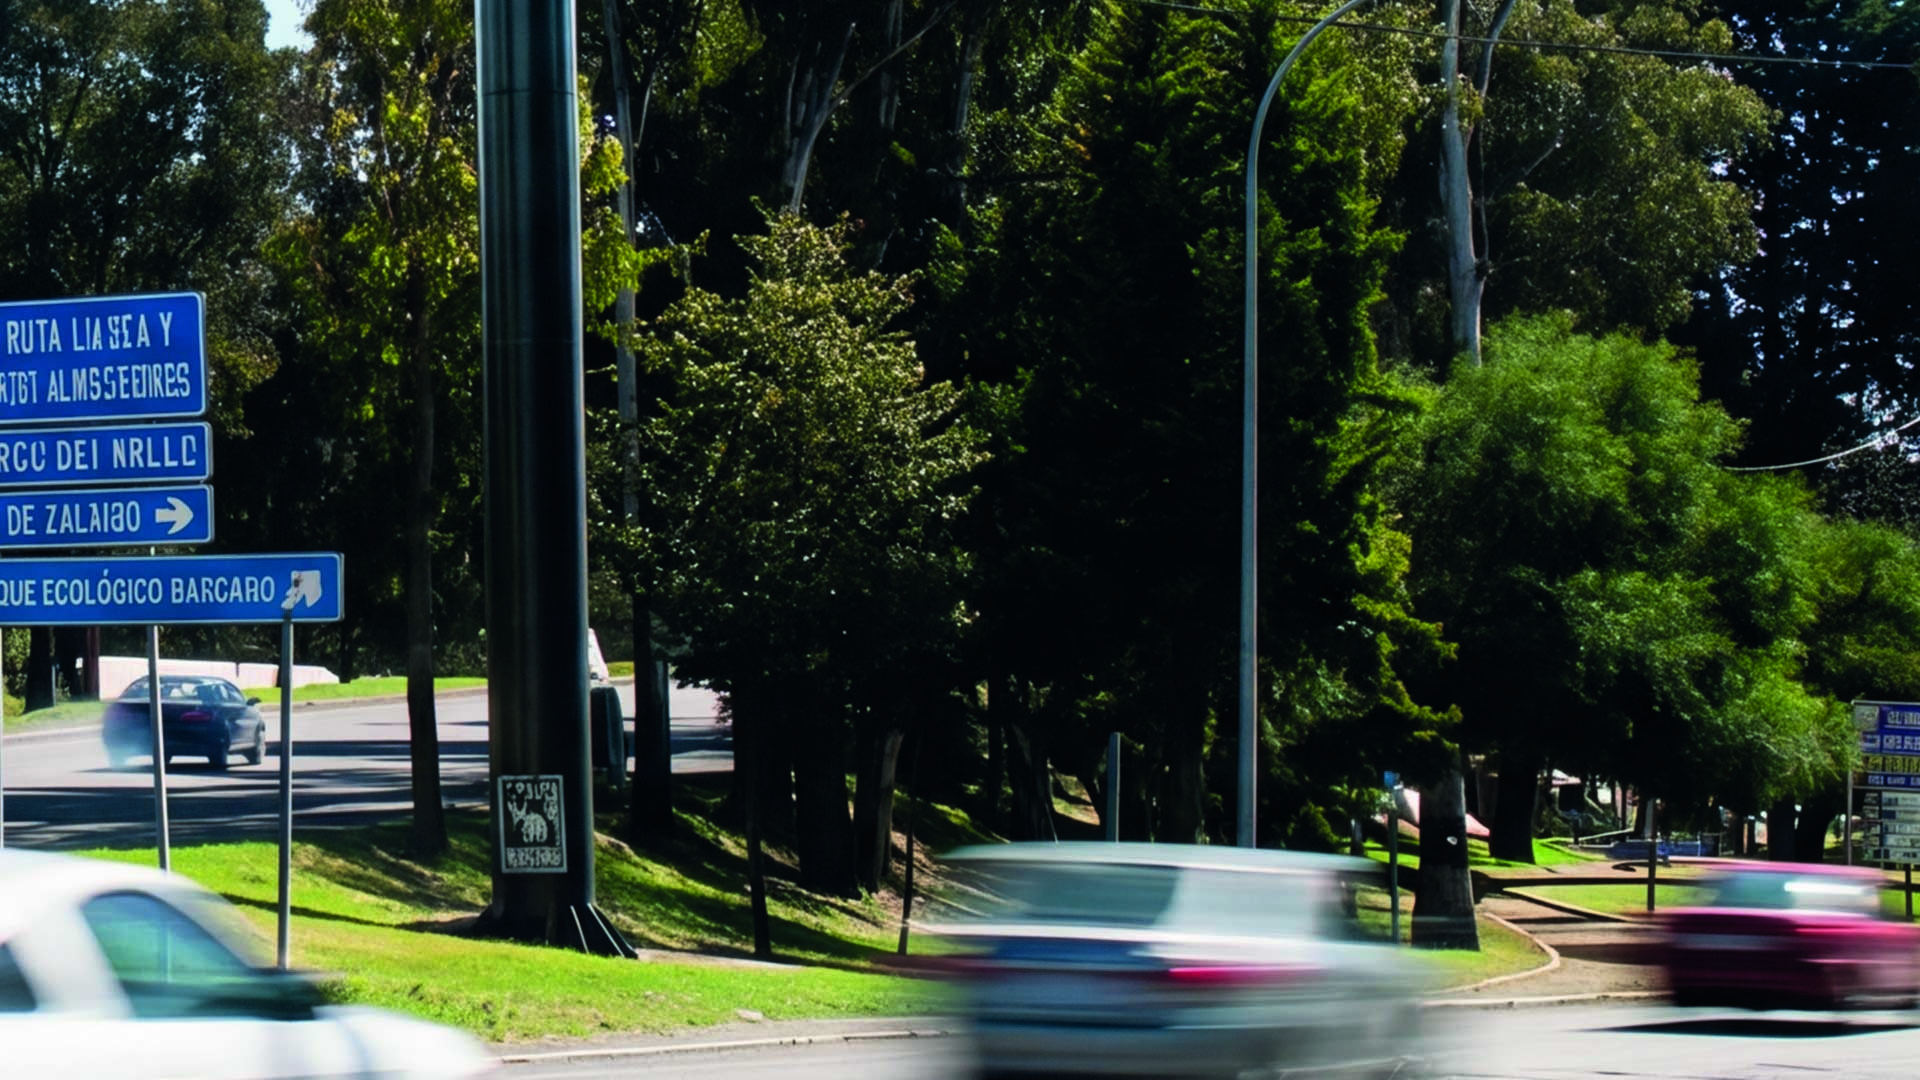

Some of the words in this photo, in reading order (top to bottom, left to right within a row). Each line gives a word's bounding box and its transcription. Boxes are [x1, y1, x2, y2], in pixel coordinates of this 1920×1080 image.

[7, 318, 62, 354] RUTA
[159, 311, 173, 347] Y
[7, 505, 36, 536] DE
[43, 569, 163, 606] ECOLÓGICO
